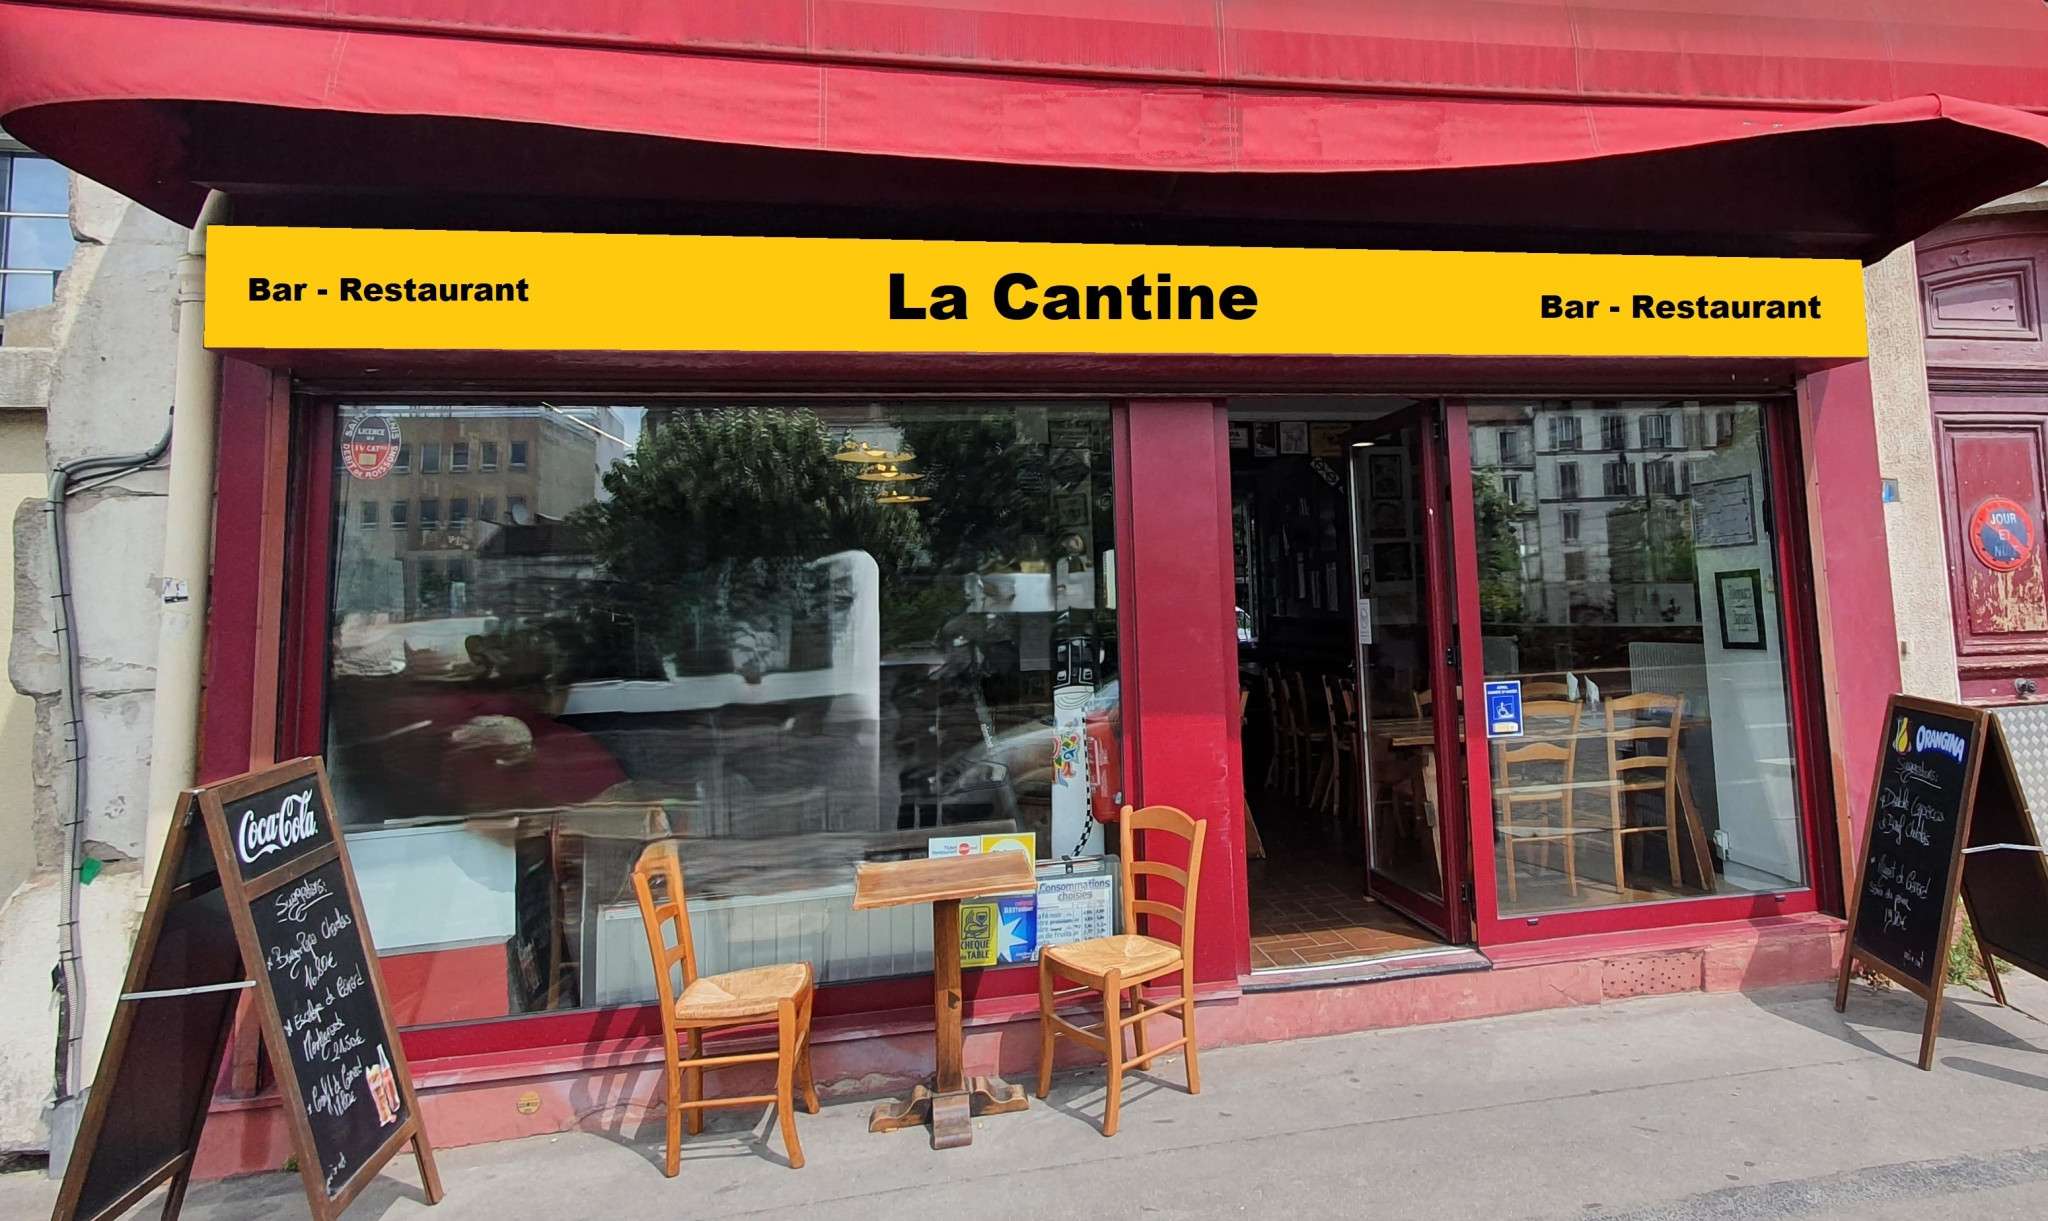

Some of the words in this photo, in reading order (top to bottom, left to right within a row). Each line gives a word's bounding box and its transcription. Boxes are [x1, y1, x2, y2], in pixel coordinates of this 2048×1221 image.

[248, 277, 308, 302] Bar
[340, 277, 529, 302] Restaurant
[890, 273, 967, 320] La
[993, 272, 1258, 321] Cantine
[1541, 294, 1600, 319] Bar
[1632, 294, 1822, 319] Restaurant
[1990, 512, 2017, 526] JOUR
[1916, 724, 1965, 763] ORANGINA
[238, 788, 318, 864] Coca-Cola
[1039, 879, 1111, 894] Consommations
[967, 949, 990, 960] TABLE
